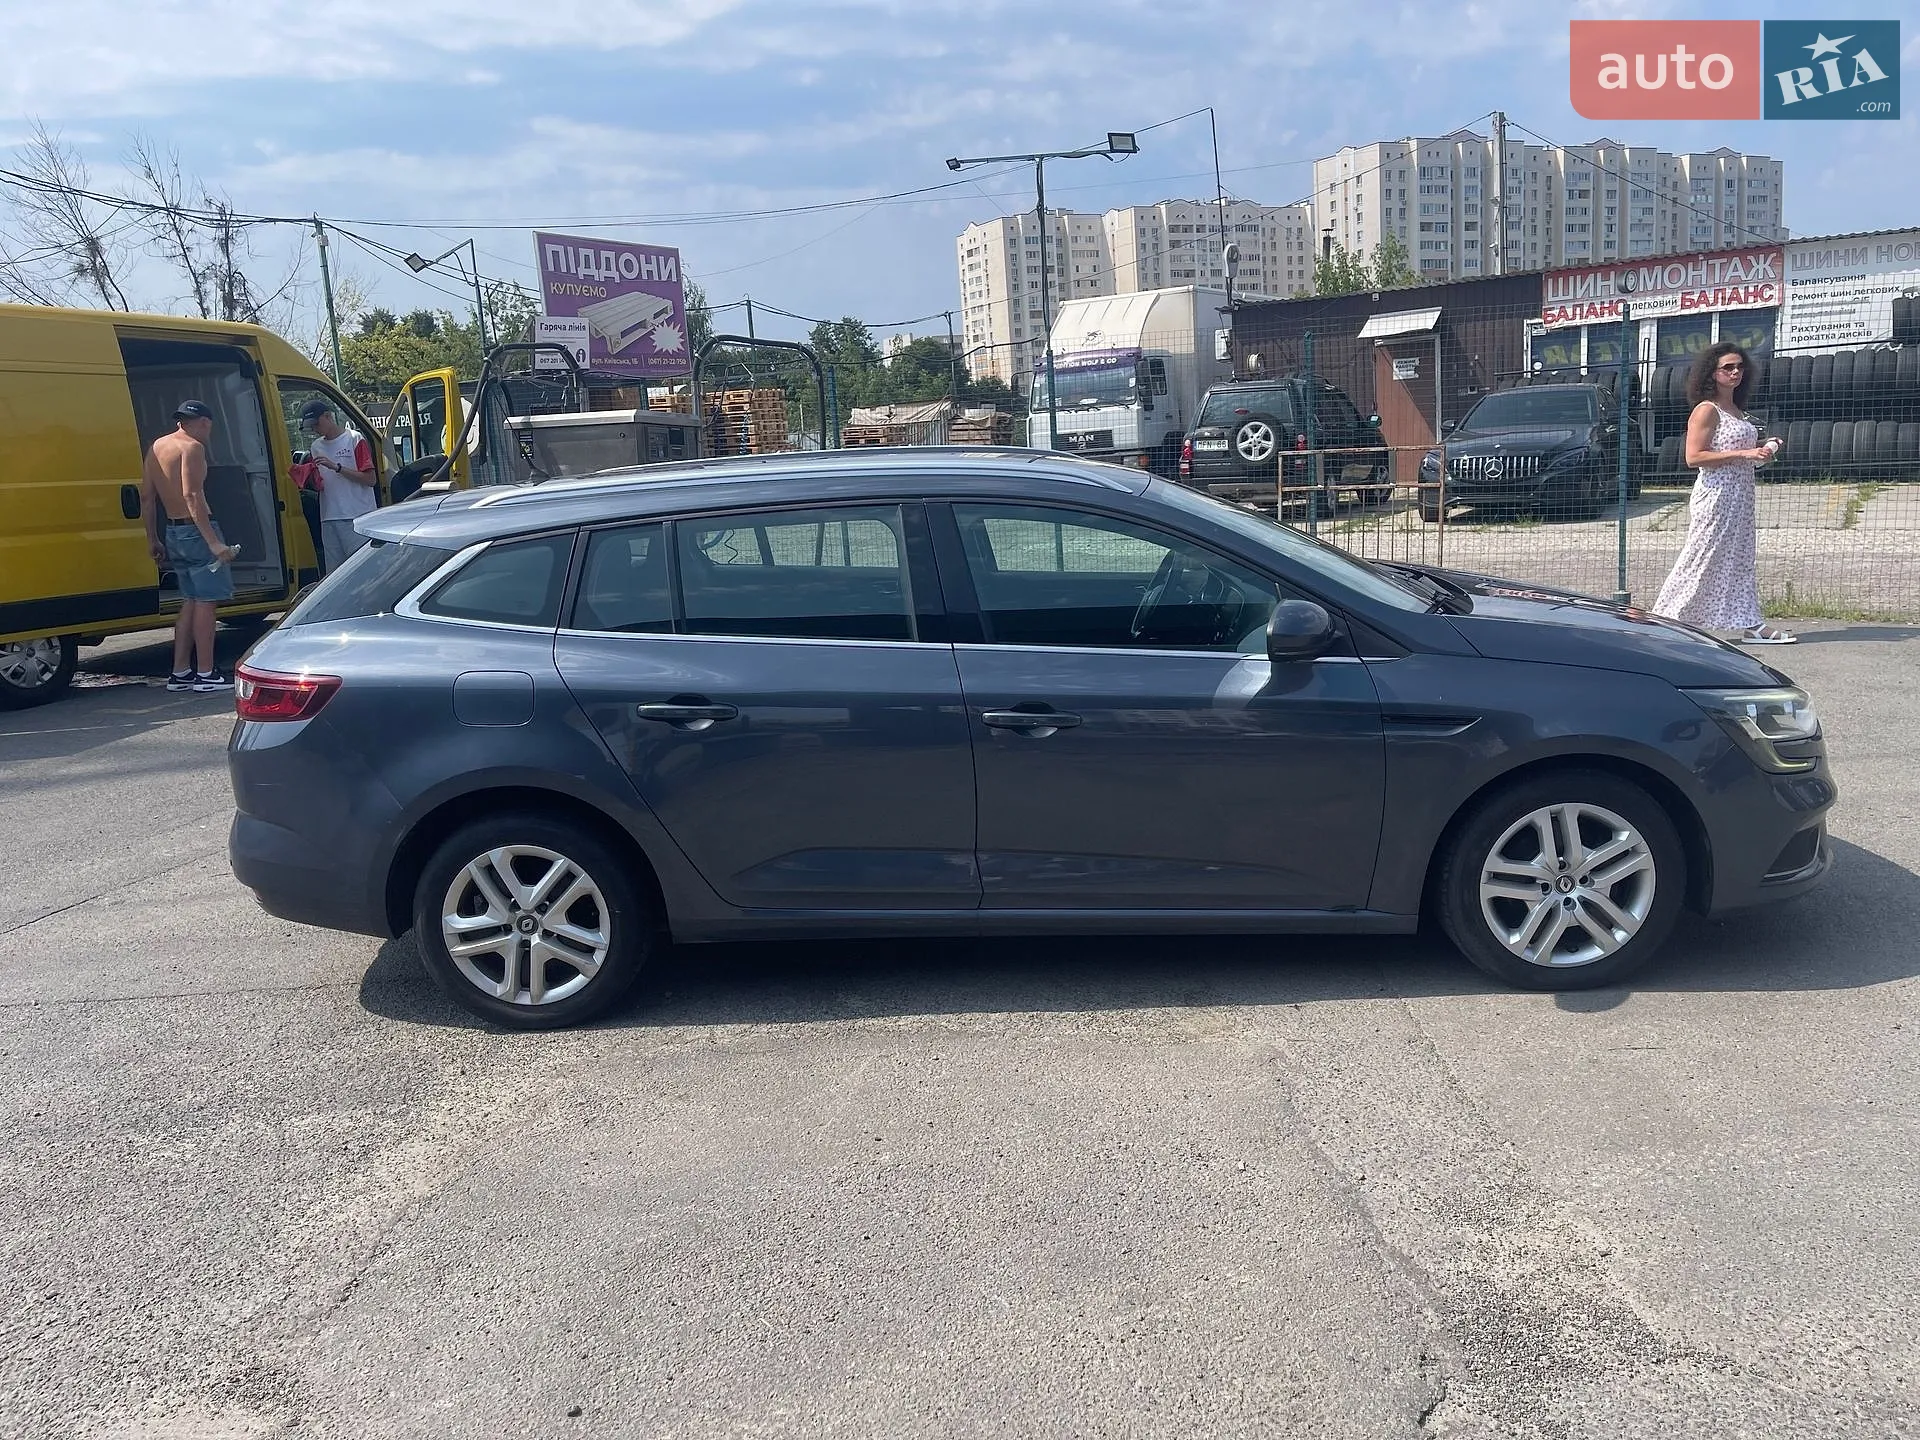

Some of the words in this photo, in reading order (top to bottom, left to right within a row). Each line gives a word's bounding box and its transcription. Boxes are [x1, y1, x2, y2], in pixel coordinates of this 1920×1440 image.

[545, 244, 678, 283] ПІДДОНИ
[1791, 247, 1868, 271] ШИНИ
[1548, 252, 1776, 302] ШИНОМОНТАЖ
[1791, 274, 1866, 287] Балансування
[551, 282, 607, 298] КУПУЄМО
[1681, 284, 1775, 310] БАЛАНС
[1791, 292, 1828, 302] Ремонт
[1830, 288, 1852, 298] шин
[540, 322, 567, 332] Гаряча
[568, 322, 587, 331] лінія
[1791, 323, 1851, 333] Рихтування
[1791, 333, 1836, 343] прокатка
[1838, 330, 1873, 339] дисків
